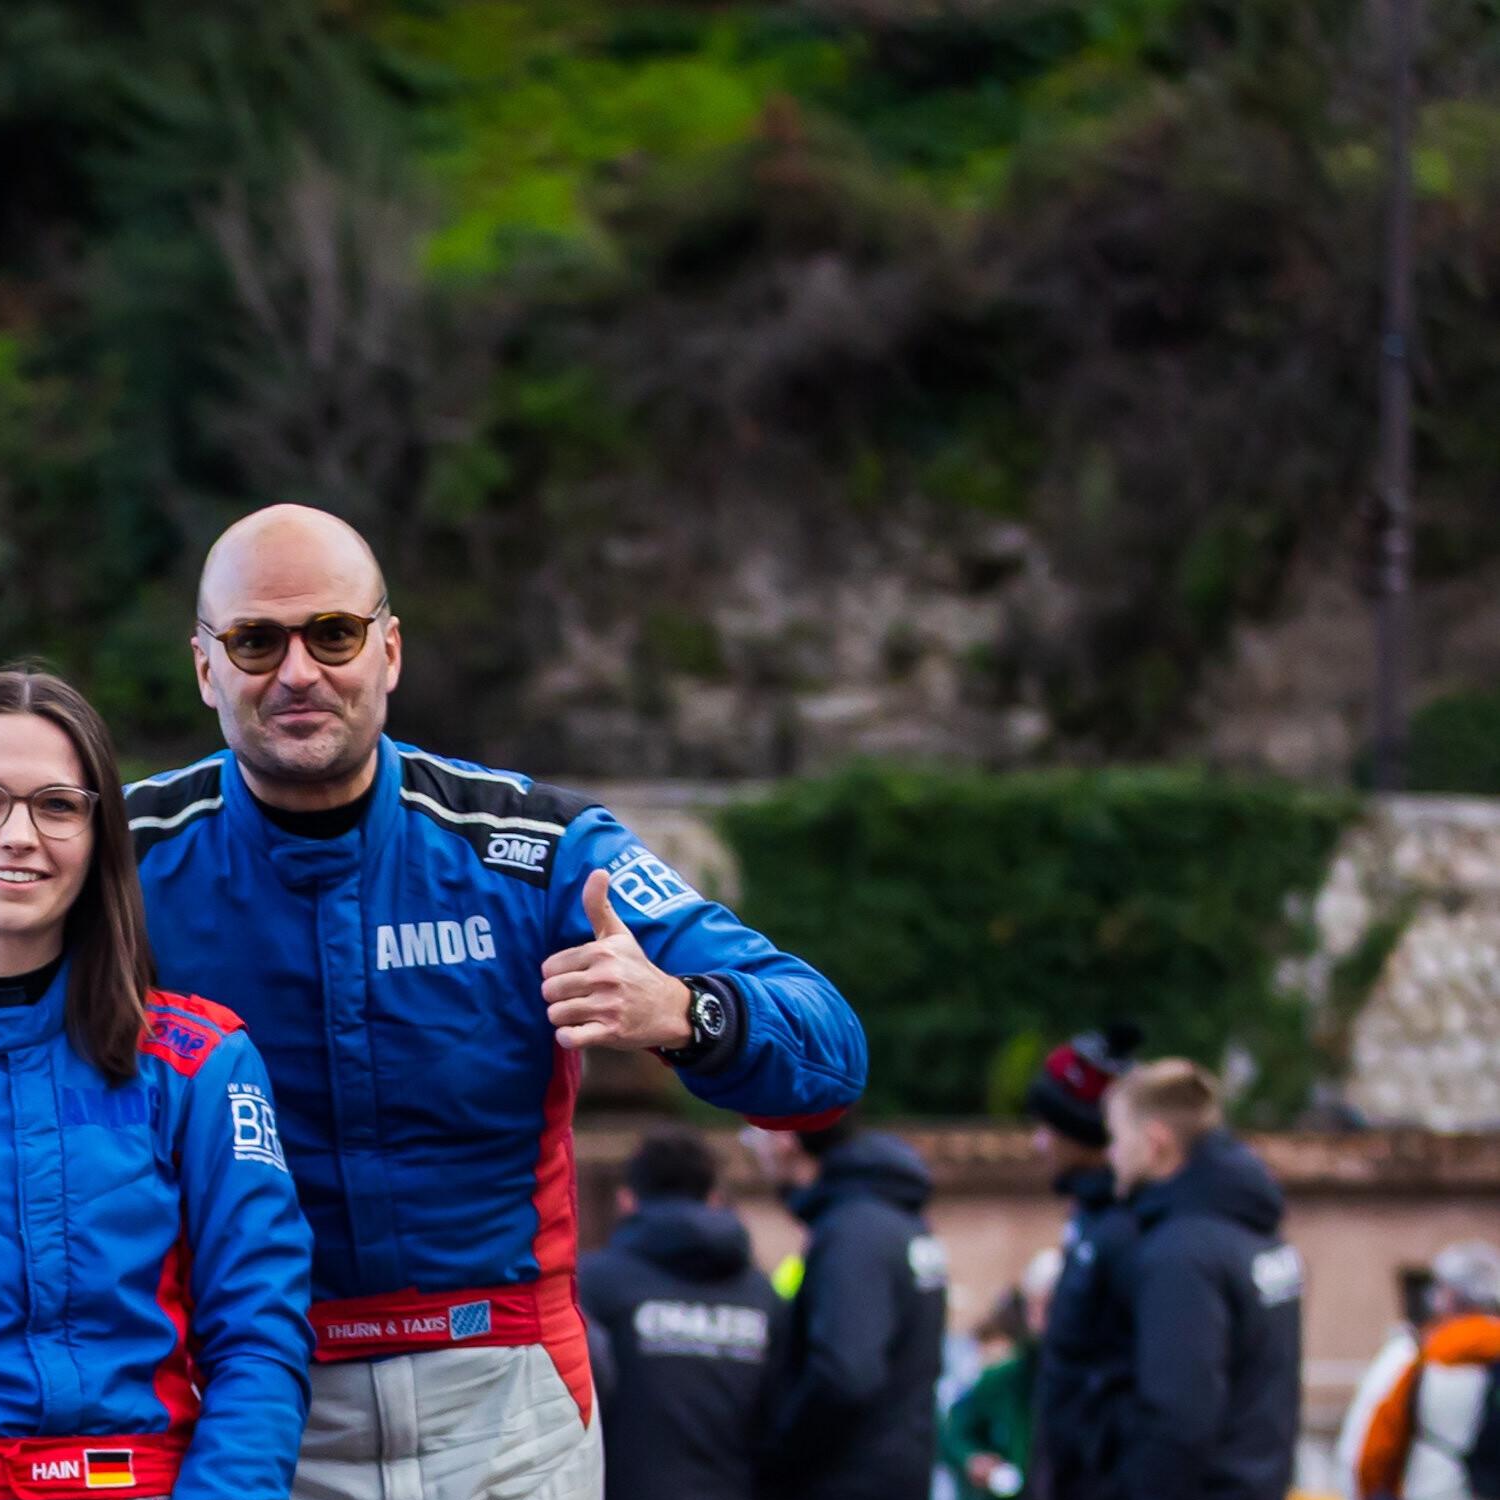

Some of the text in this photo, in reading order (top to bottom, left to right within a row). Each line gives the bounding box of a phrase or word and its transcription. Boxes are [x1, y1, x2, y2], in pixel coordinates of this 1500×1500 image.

[488, 839, 548, 865] OMP
[377, 915, 496, 970] AMDG
[152, 1020, 205, 1052] OMP
[327, 1316, 448, 1339] THURN & TAXIS
[31, 1460, 81, 1481] HAIN
